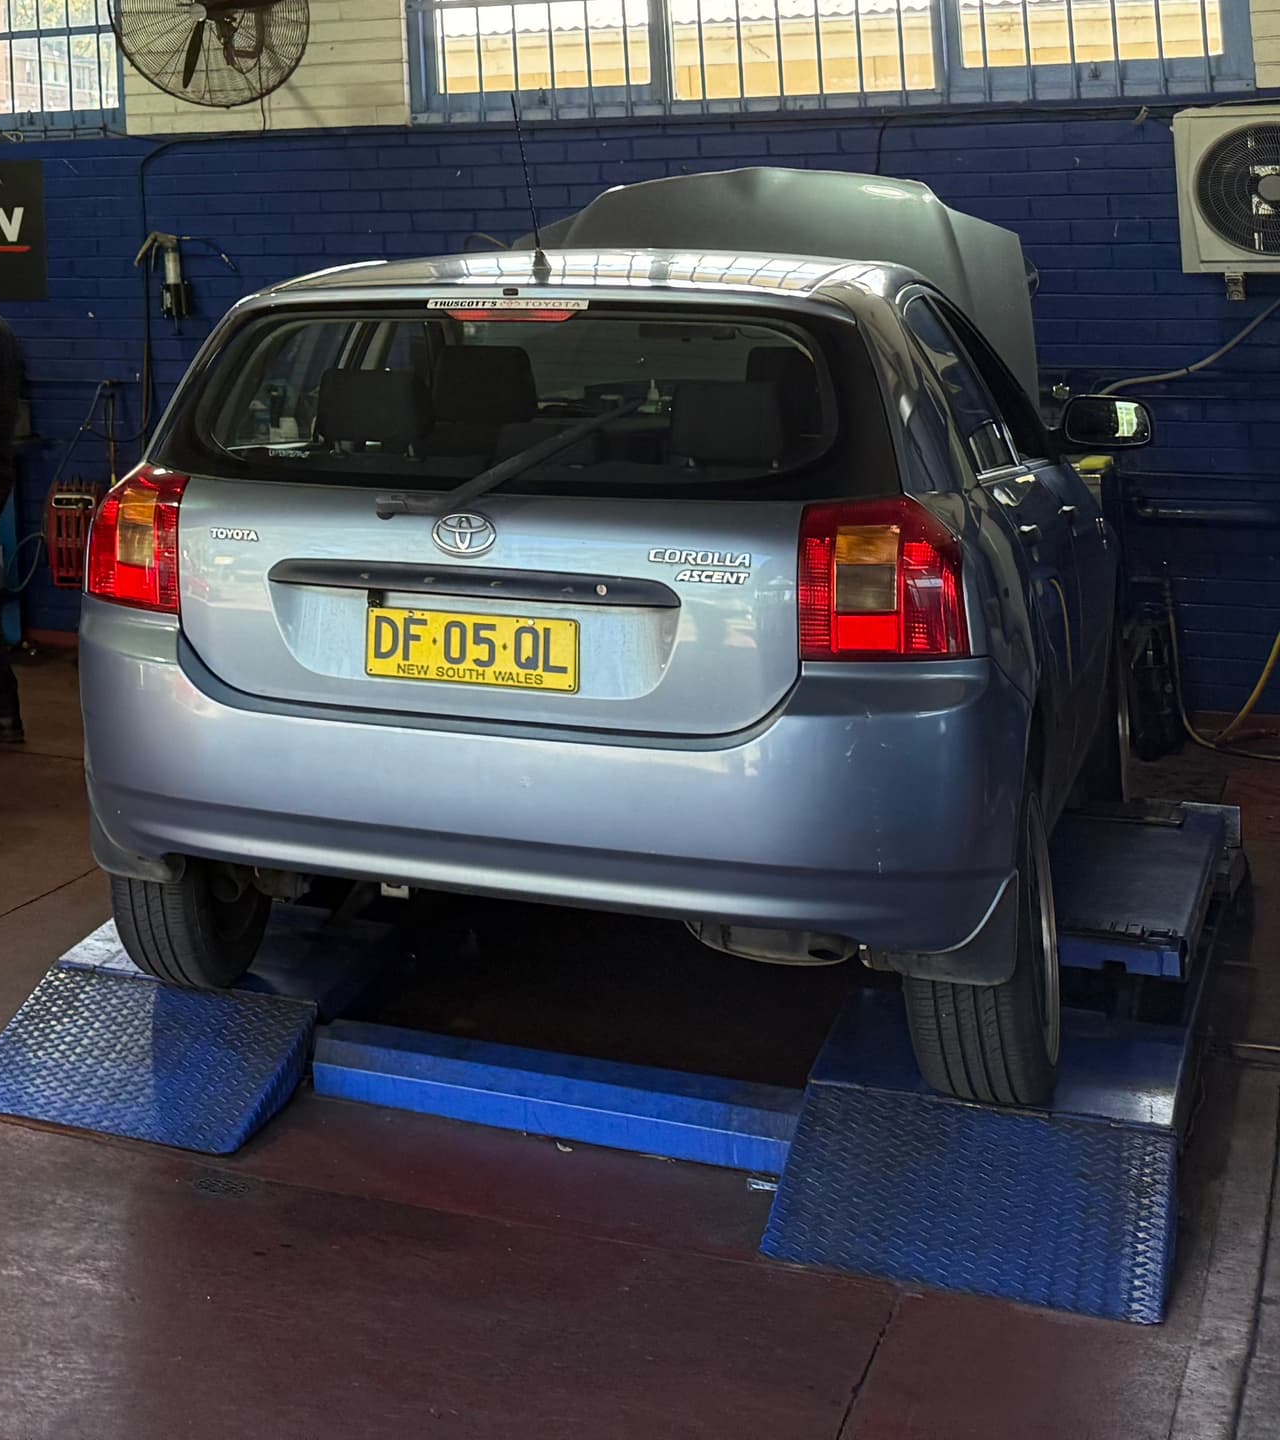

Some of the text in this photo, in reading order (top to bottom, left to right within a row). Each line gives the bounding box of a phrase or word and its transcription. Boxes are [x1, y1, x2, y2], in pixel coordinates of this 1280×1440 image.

[525, 300, 581, 309] TOYOTA
[210, 527, 259, 541] TOYOTA
[648, 548, 752, 568] COROLLA
[675, 569, 750, 585] ASCENT
[396, 663, 544, 685] NEW SOUTH WALES
